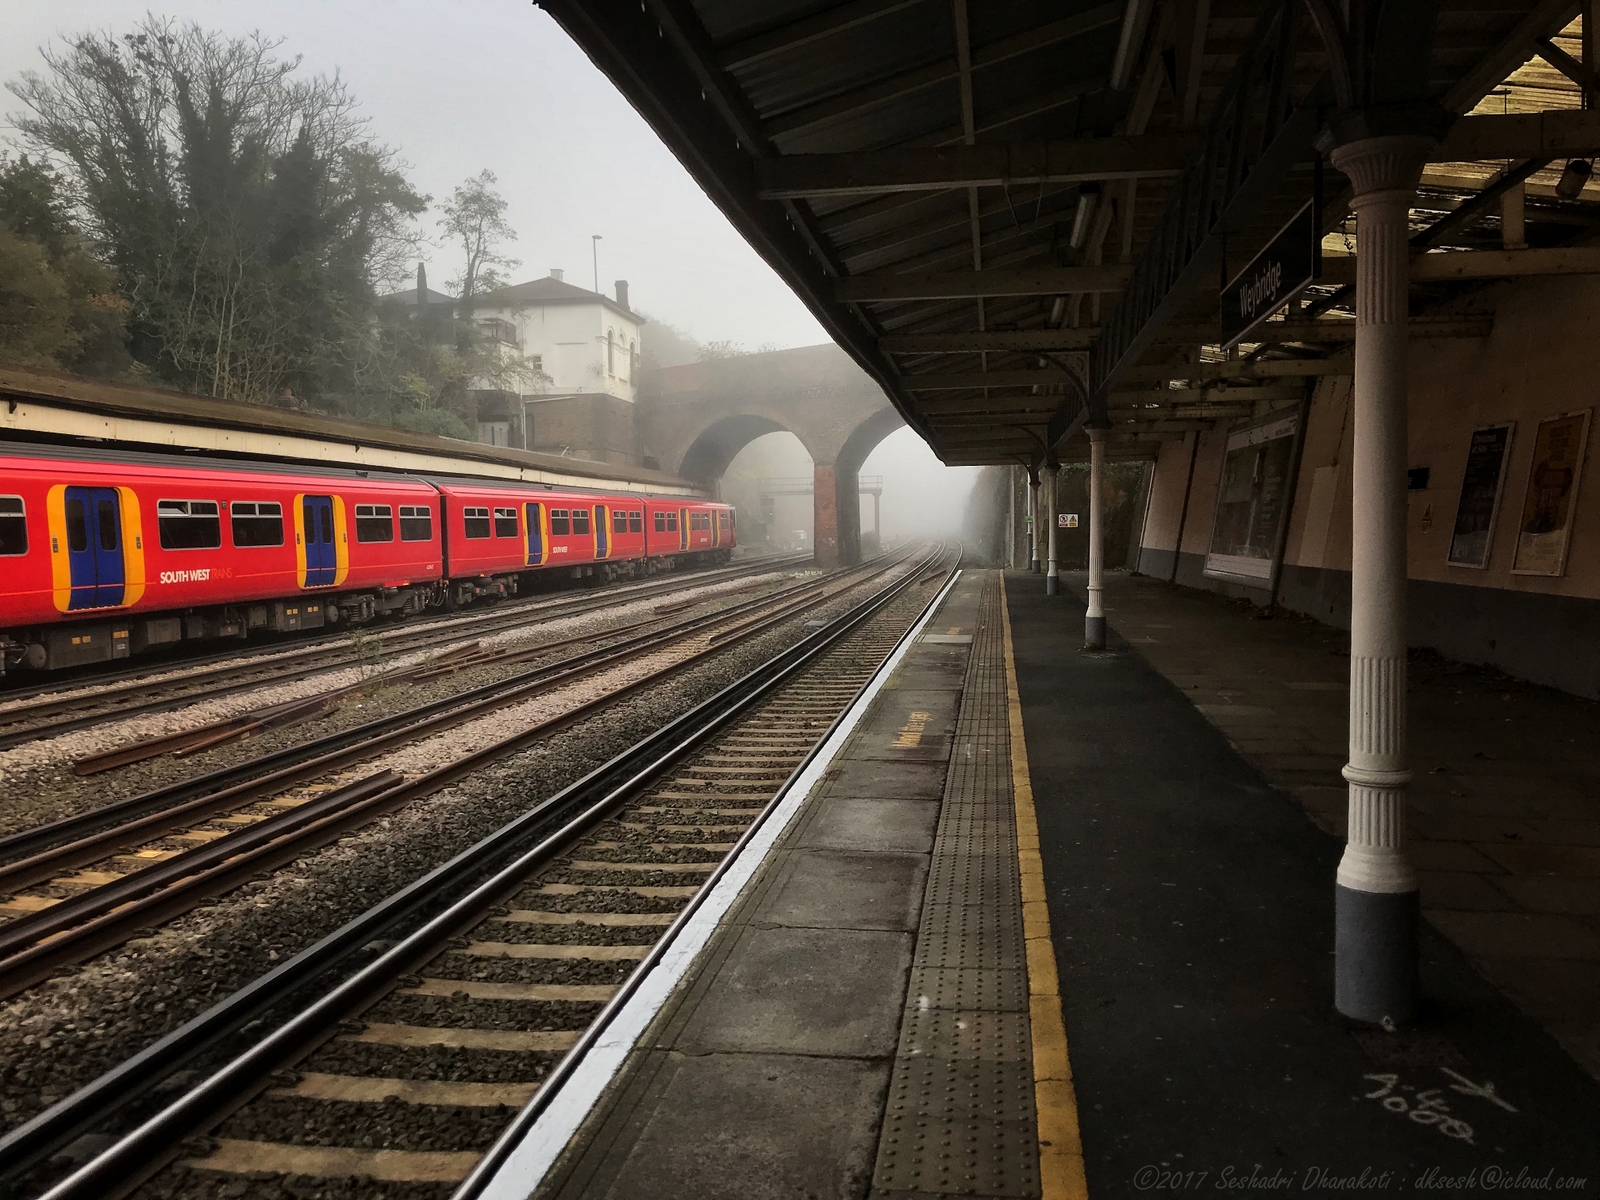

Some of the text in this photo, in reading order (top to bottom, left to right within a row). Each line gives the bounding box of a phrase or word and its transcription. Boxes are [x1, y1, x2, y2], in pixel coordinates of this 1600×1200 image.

[1240, 261, 1281, 318] Weybridge
[160, 567, 232, 584] SOUTH WEST TRAINS
